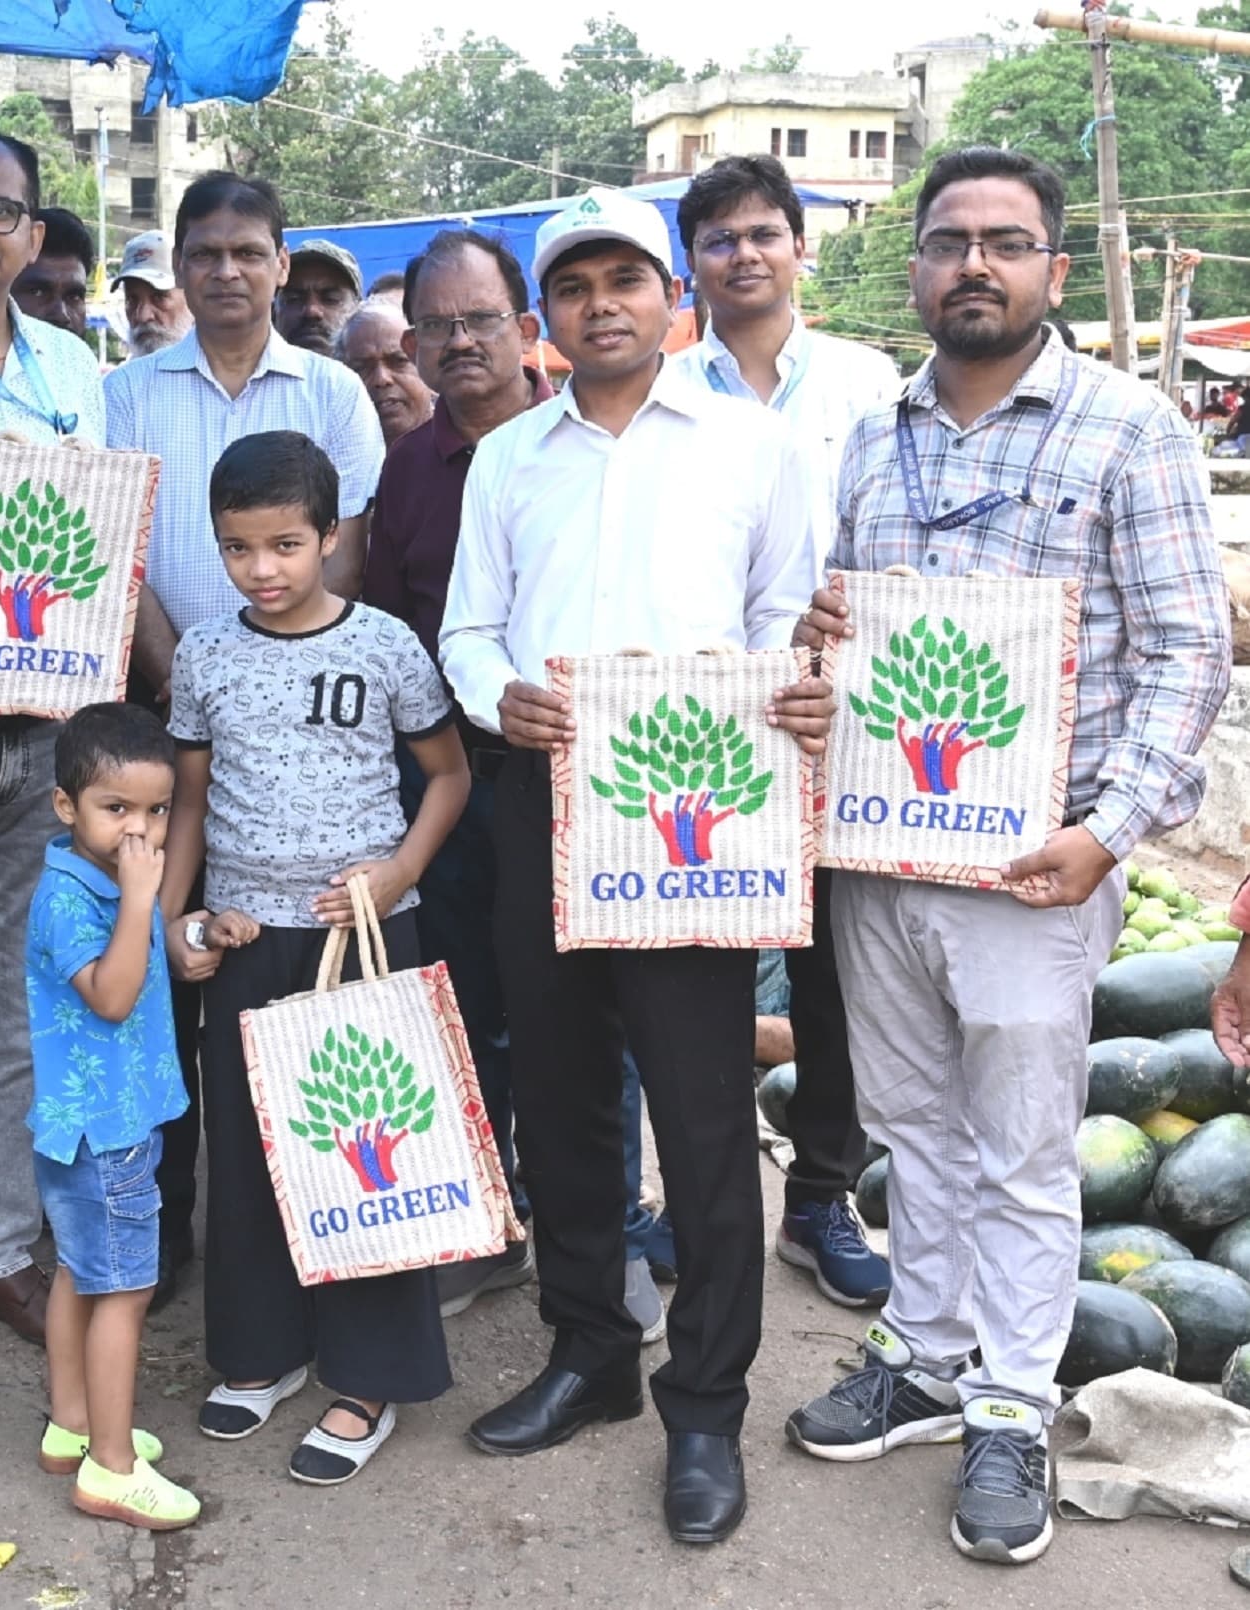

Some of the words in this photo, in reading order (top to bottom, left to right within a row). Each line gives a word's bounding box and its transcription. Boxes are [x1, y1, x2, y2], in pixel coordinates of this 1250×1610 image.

[305, 671, 366, 728] 10
[837, 794, 889, 826] GO
[899, 800, 1025, 836] GREEN
[591, 872, 646, 902] GO
[657, 869, 788, 900] GREEN
[310, 1206, 349, 1238] GO
[357, 1178, 471, 1229] GREEN
